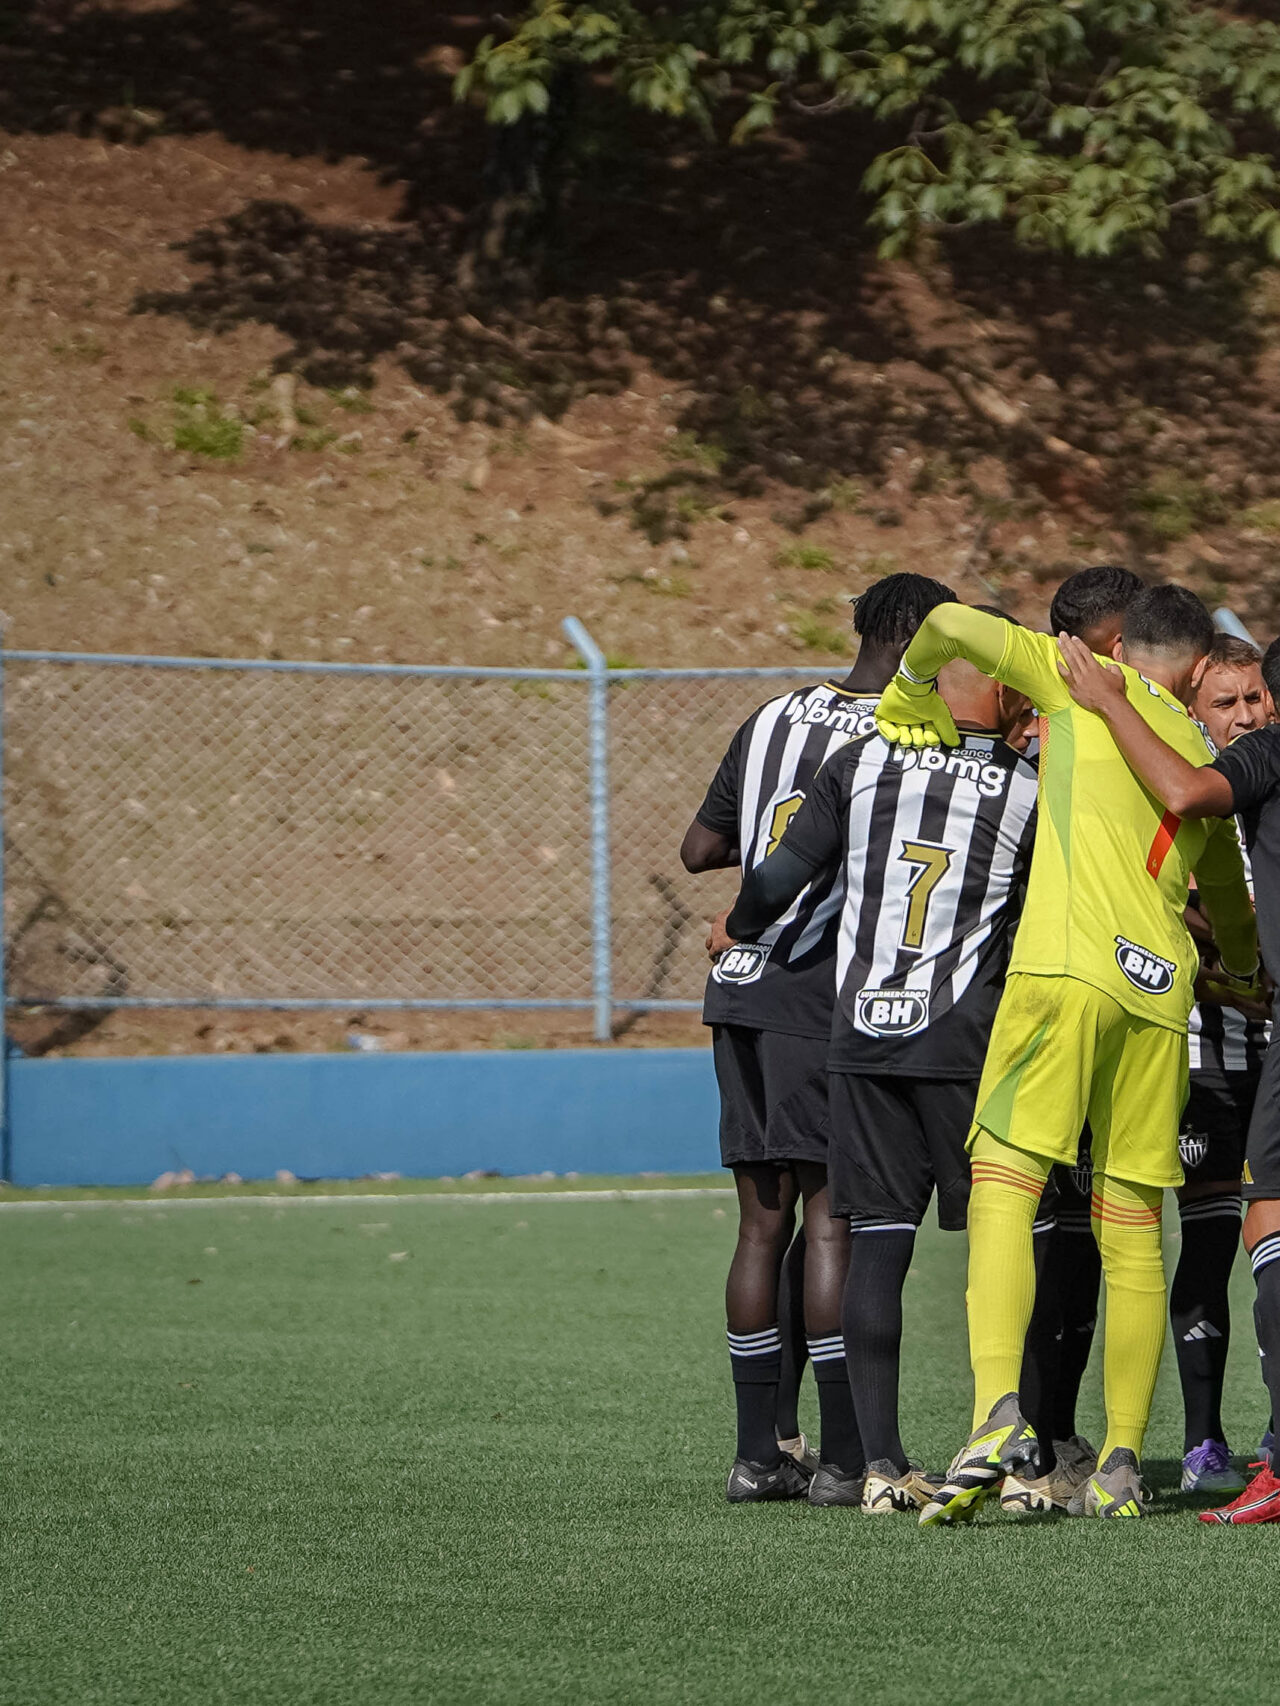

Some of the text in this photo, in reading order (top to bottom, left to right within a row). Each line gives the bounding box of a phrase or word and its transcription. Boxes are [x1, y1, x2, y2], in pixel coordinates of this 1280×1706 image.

[837, 701, 874, 711] banco
[951, 748, 993, 760] banco
[919, 748, 1008, 797] bmg
[896, 839, 957, 949] 7
[721, 951, 759, 974] BH
[1124, 950, 1165, 986] BH
[870, 1000, 914, 1025] BH
